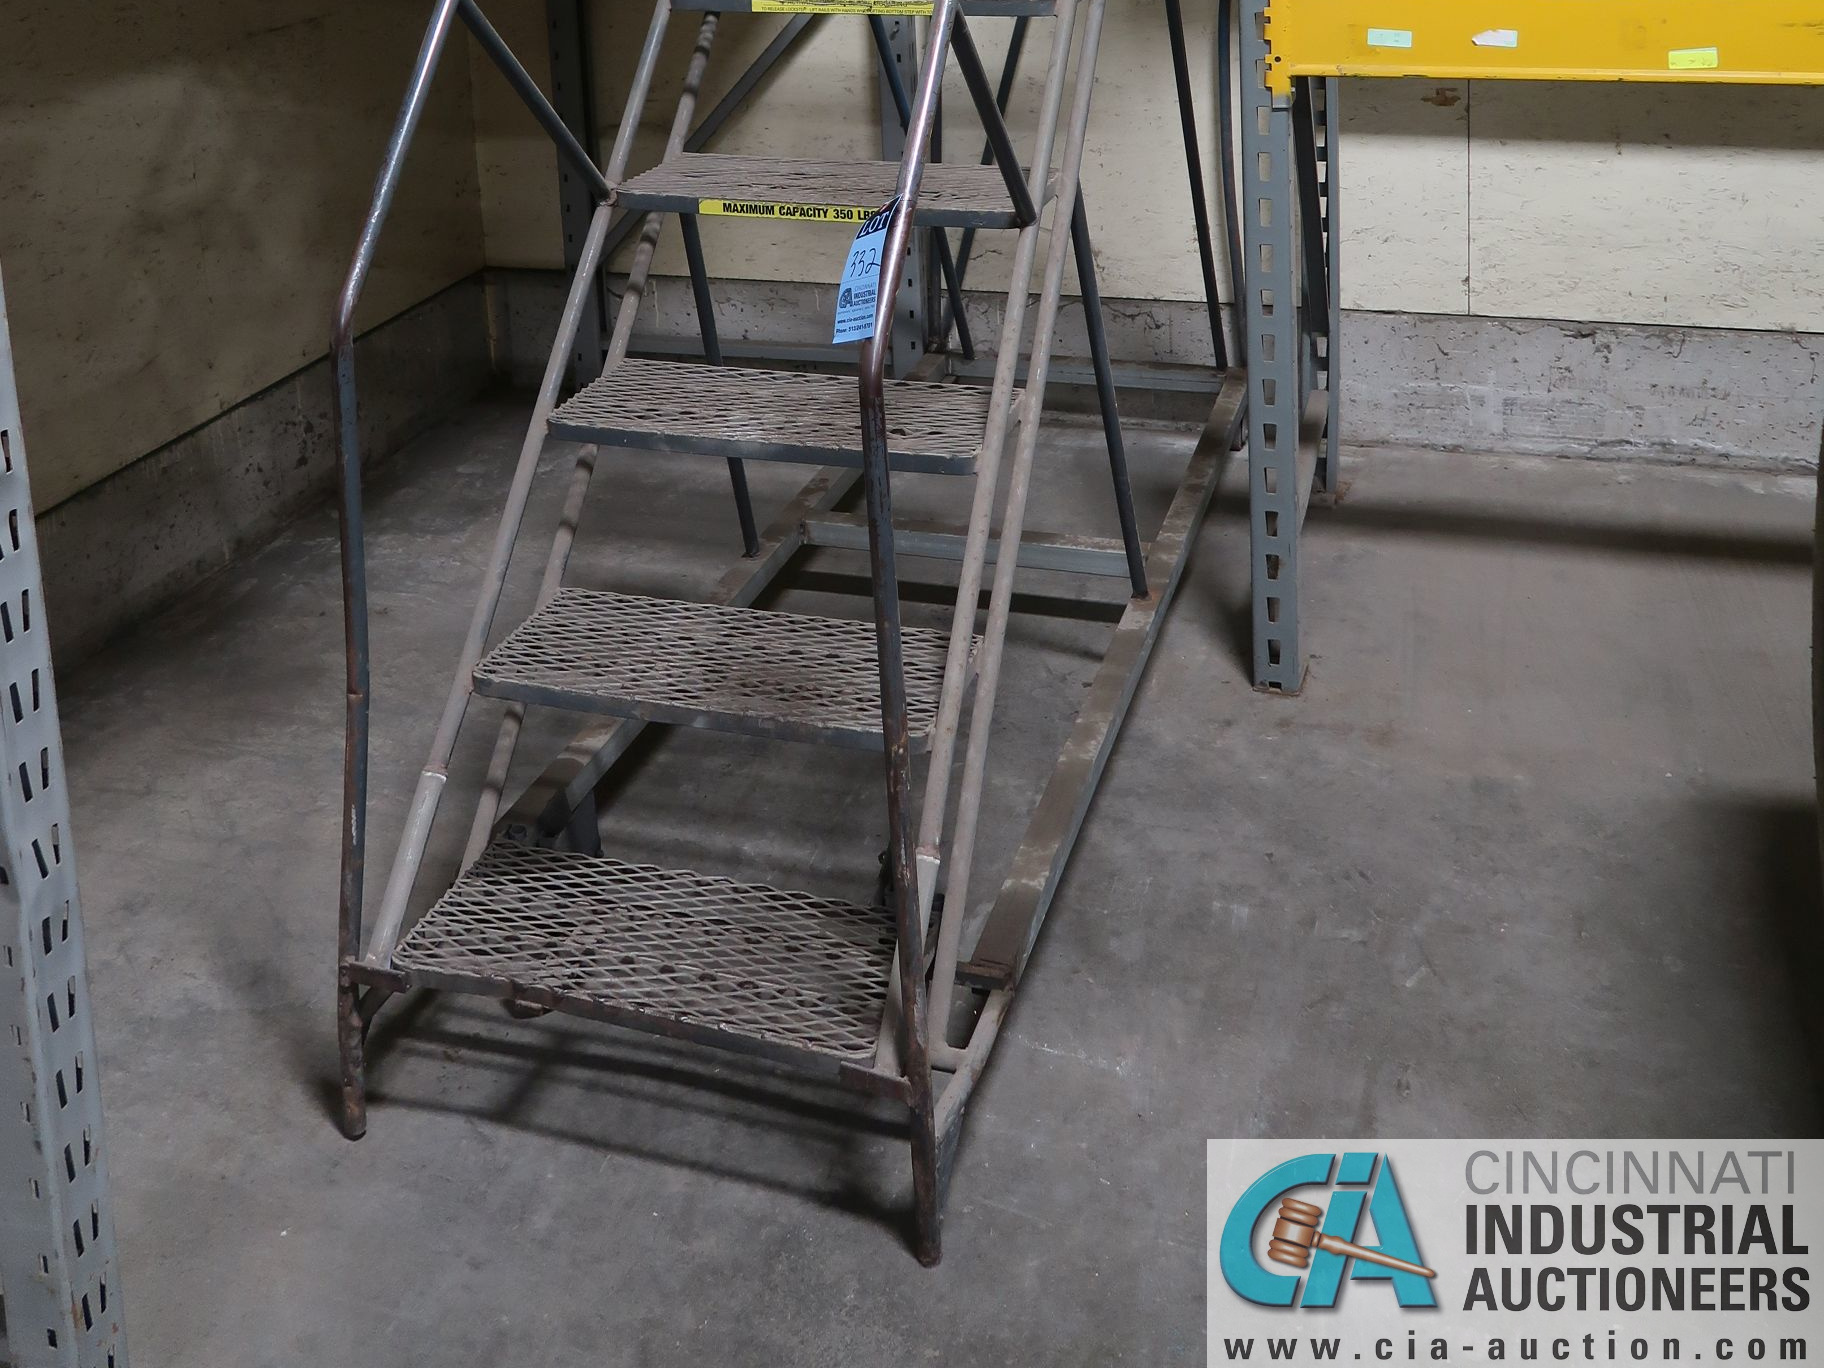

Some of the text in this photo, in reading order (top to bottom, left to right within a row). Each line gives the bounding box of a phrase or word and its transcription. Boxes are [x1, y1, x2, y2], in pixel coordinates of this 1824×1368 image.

[722, 202, 775, 216] MAXIMUM
[778, 206, 829, 219] CAPACITY
[833, 209, 853, 220] 350
[860, 211, 890, 235] LOT
[850, 247, 880, 278] 332
